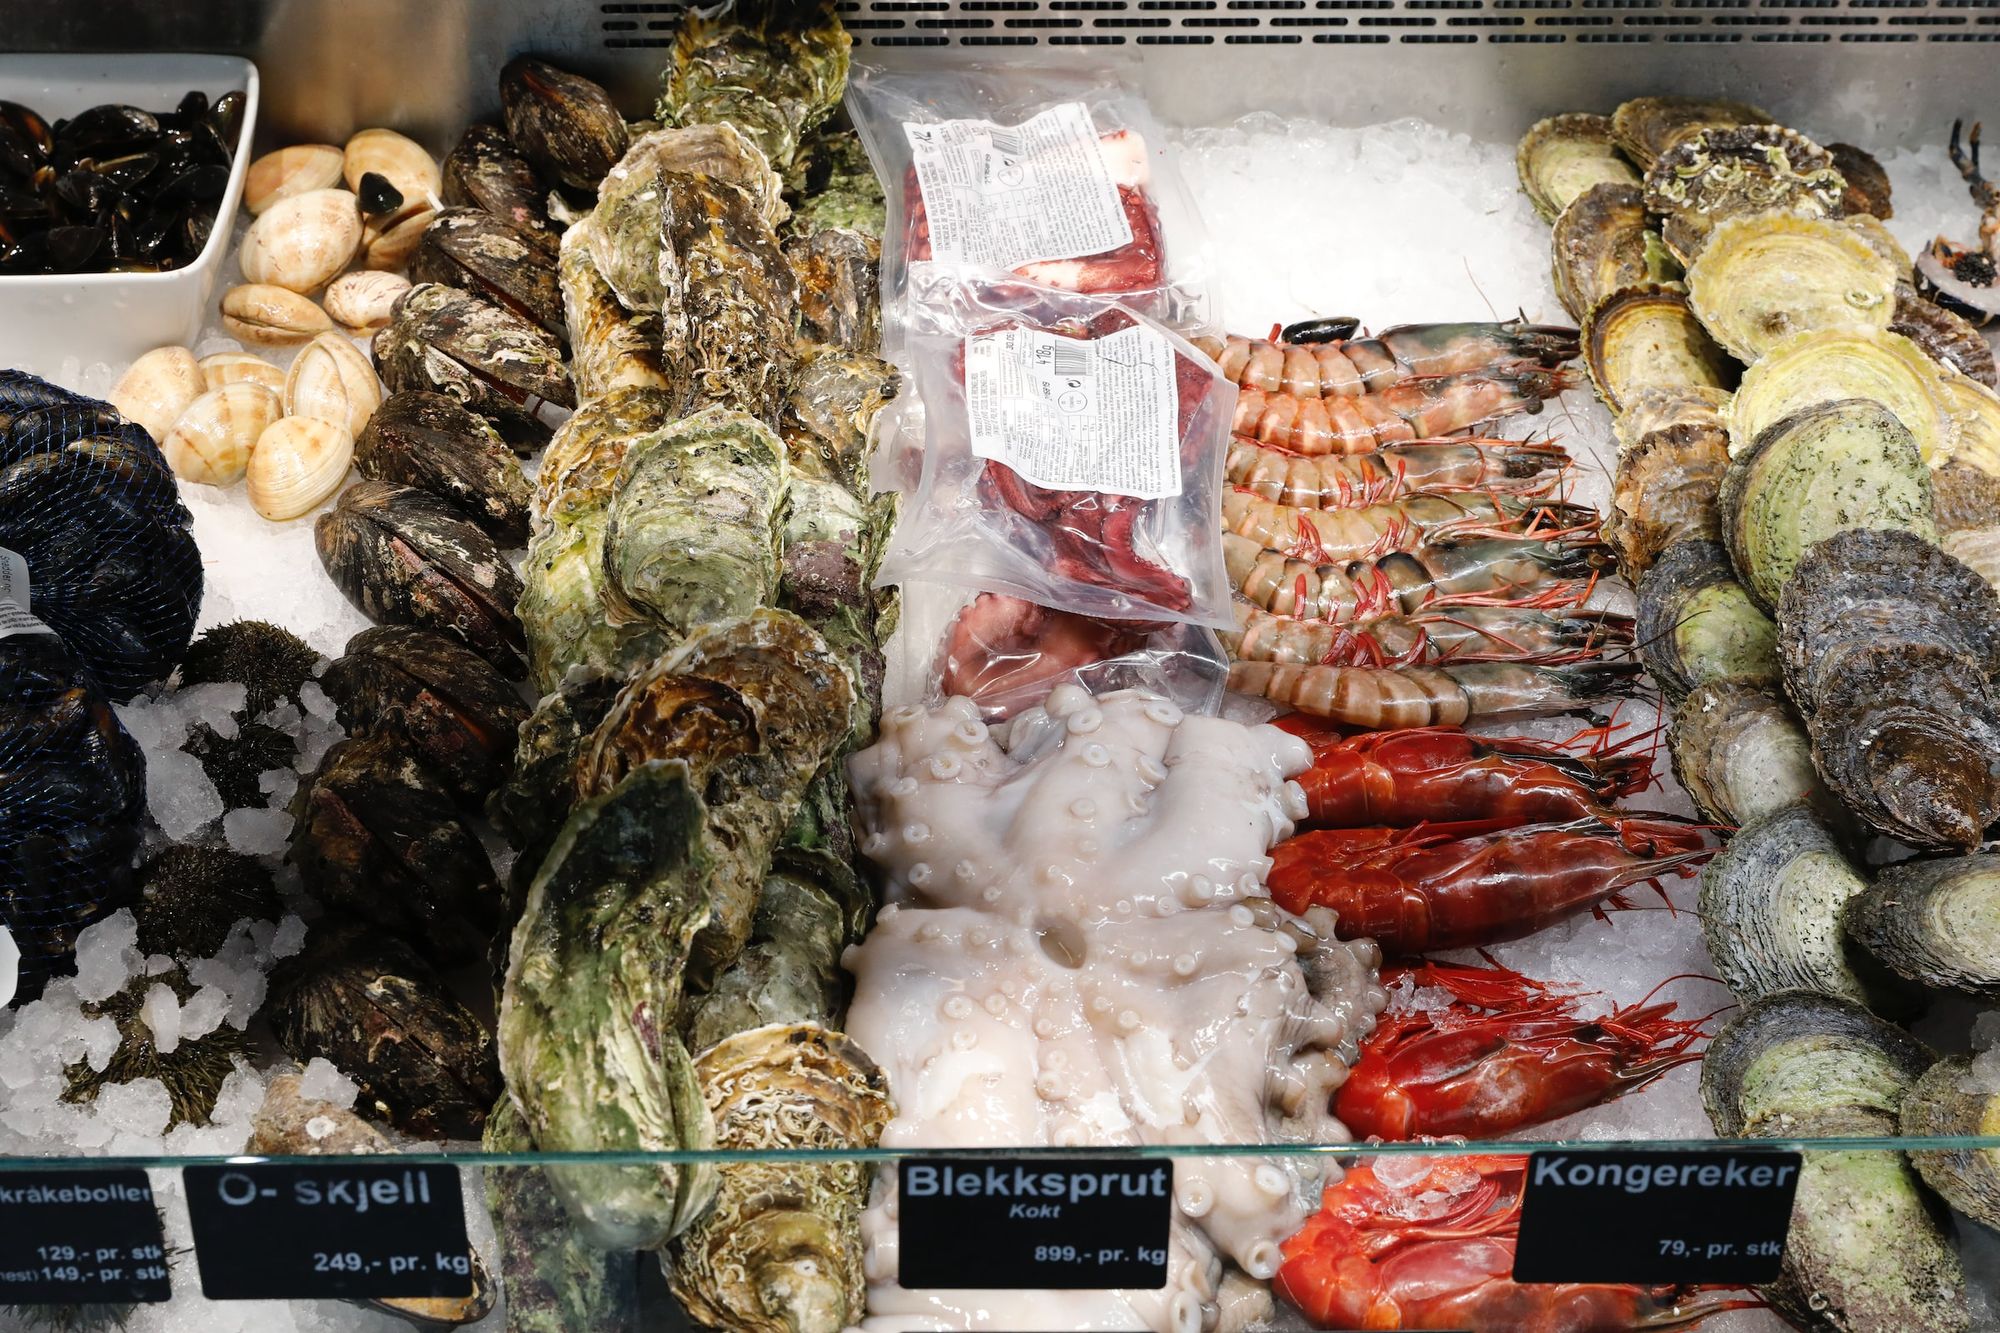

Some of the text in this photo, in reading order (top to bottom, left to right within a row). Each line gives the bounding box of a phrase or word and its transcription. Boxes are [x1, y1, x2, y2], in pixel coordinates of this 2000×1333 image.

[1035, 344, 1055, 366] 418g
[906, 1166, 1167, 1203] Blekksprut
[1534, 1157, 1795, 1194] Kongereker
[294, 1170, 431, 1214] skjell
[1009, 1204, 1061, 1219] Kokt
[37, 1245, 90, 1263] 129,-
[96, 1248, 126, 1263] pr.
[1034, 1245, 1166, 1265] 899,- pr. kg
[1658, 1239, 1782, 1259] 79,- pr. stk
[313, 1250, 468, 1276] 249,- pr. kg
[41, 1266, 95, 1283] 149,-
[100, 1269, 129, 1283] pr.
